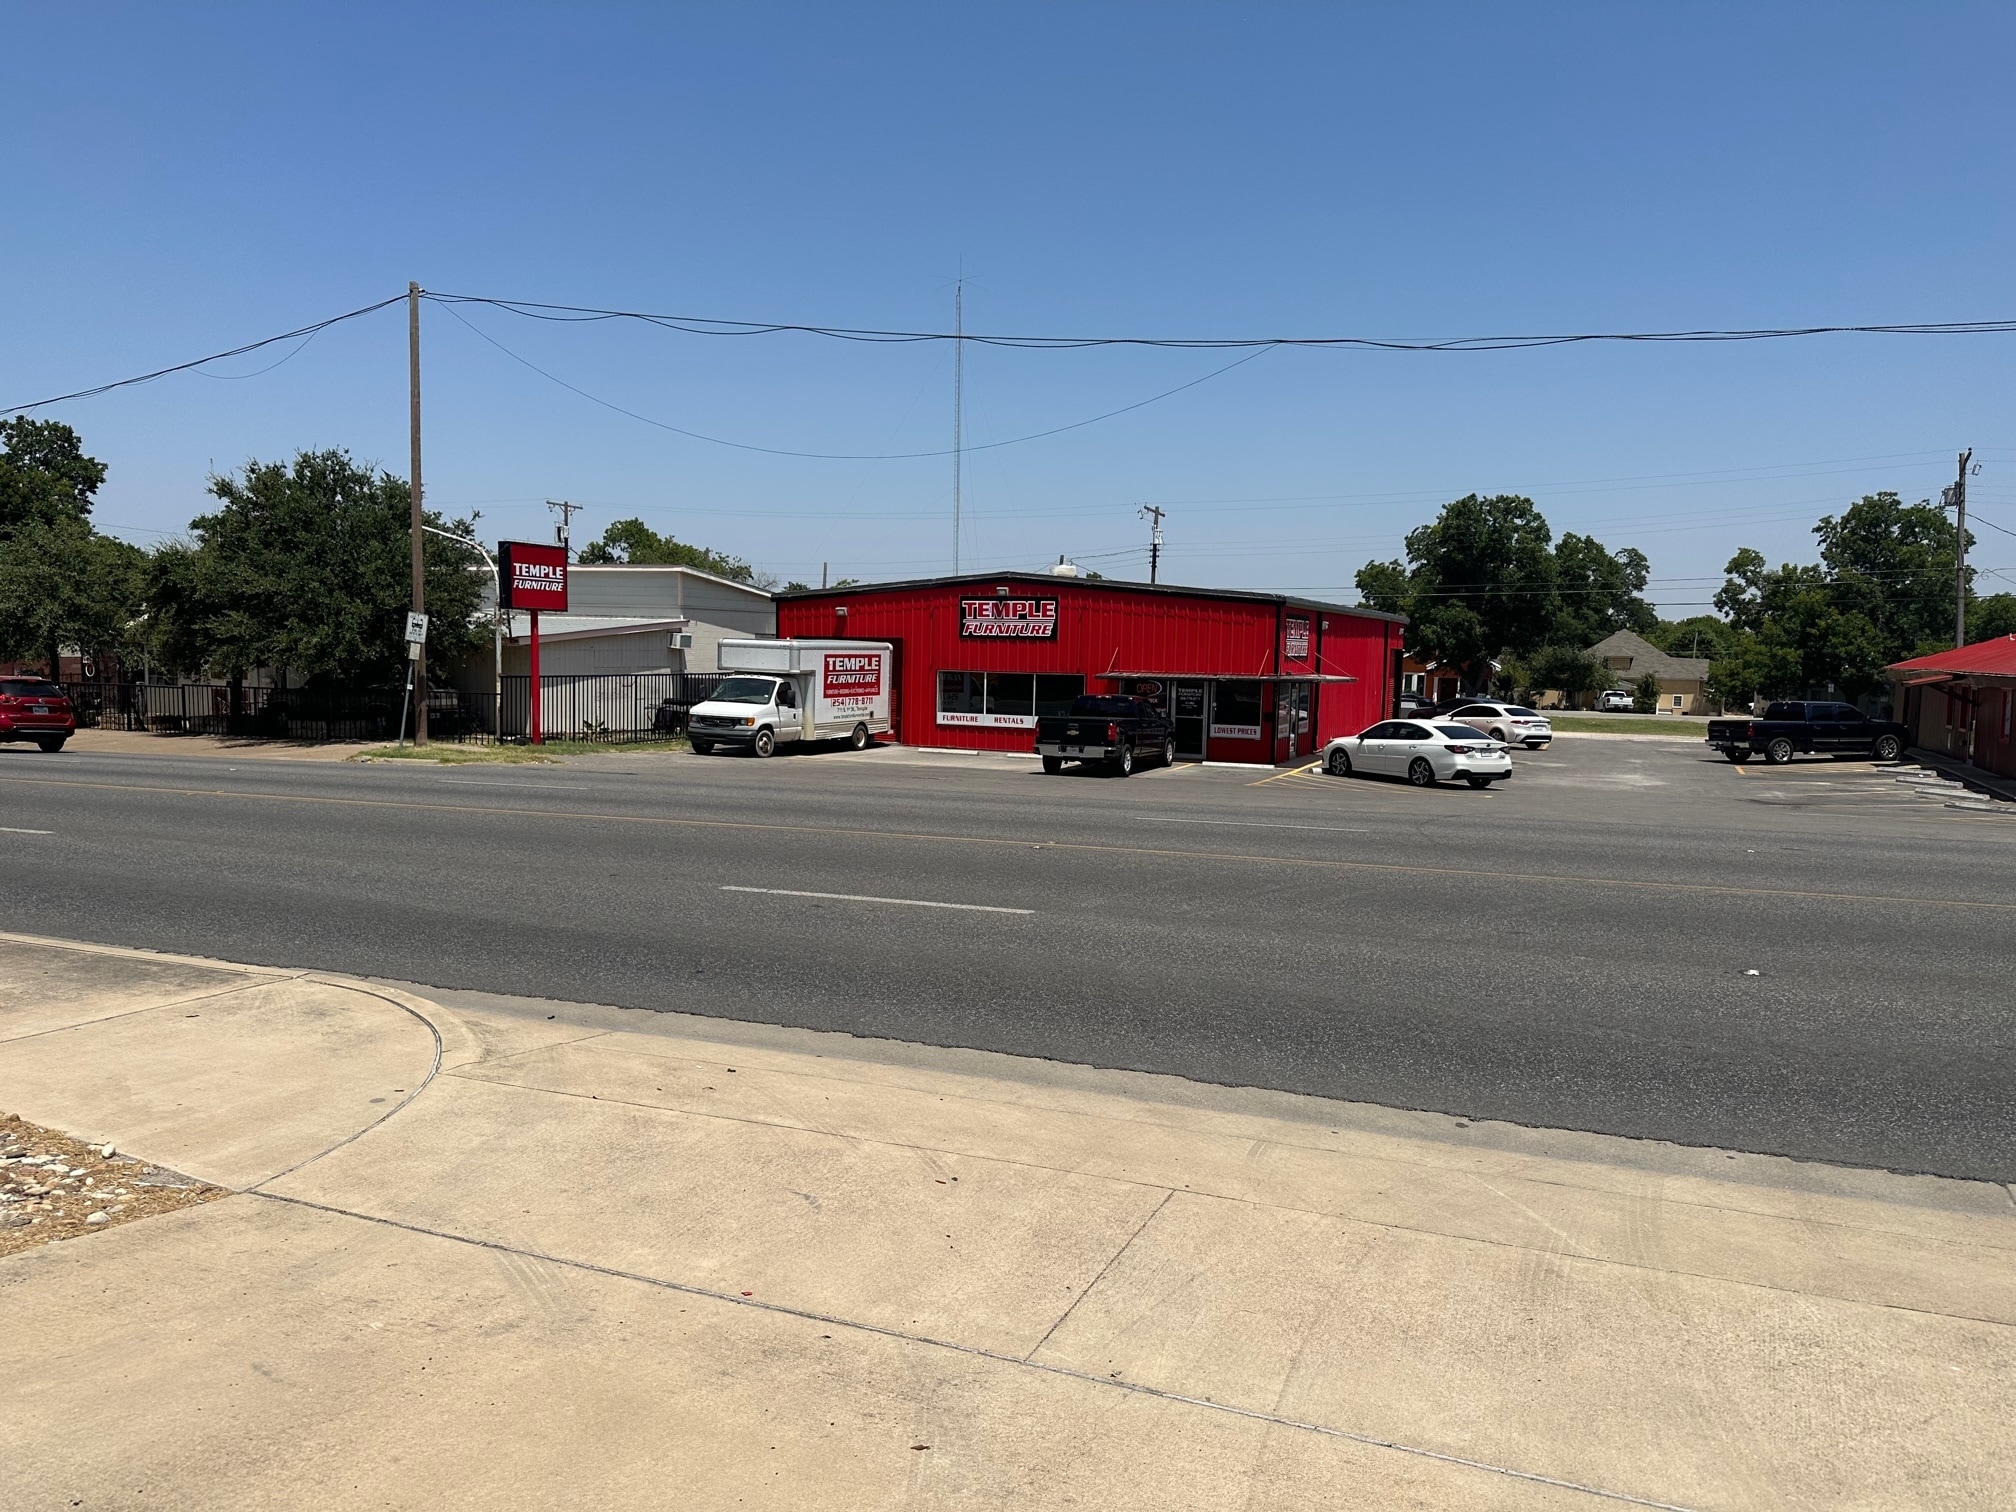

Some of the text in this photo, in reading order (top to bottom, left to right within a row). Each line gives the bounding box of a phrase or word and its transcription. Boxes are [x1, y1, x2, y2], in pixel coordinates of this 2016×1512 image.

[513, 563, 563, 578] TEMPLE
[513, 579, 563, 591] FURNITURE
[962, 600, 1056, 620] TEMPLE
[962, 623, 1053, 637] FURNITURE
[826, 657, 879, 671] TEMPLE
[827, 674, 877, 684] FURNITURE
[1136, 683, 1158, 694] OPEN
[847, 697, 874, 706] 778-8711
[942, 714, 1024, 725] FURNITURE RENTALS
[1213, 727, 1257, 736] LOWEST PRICES
